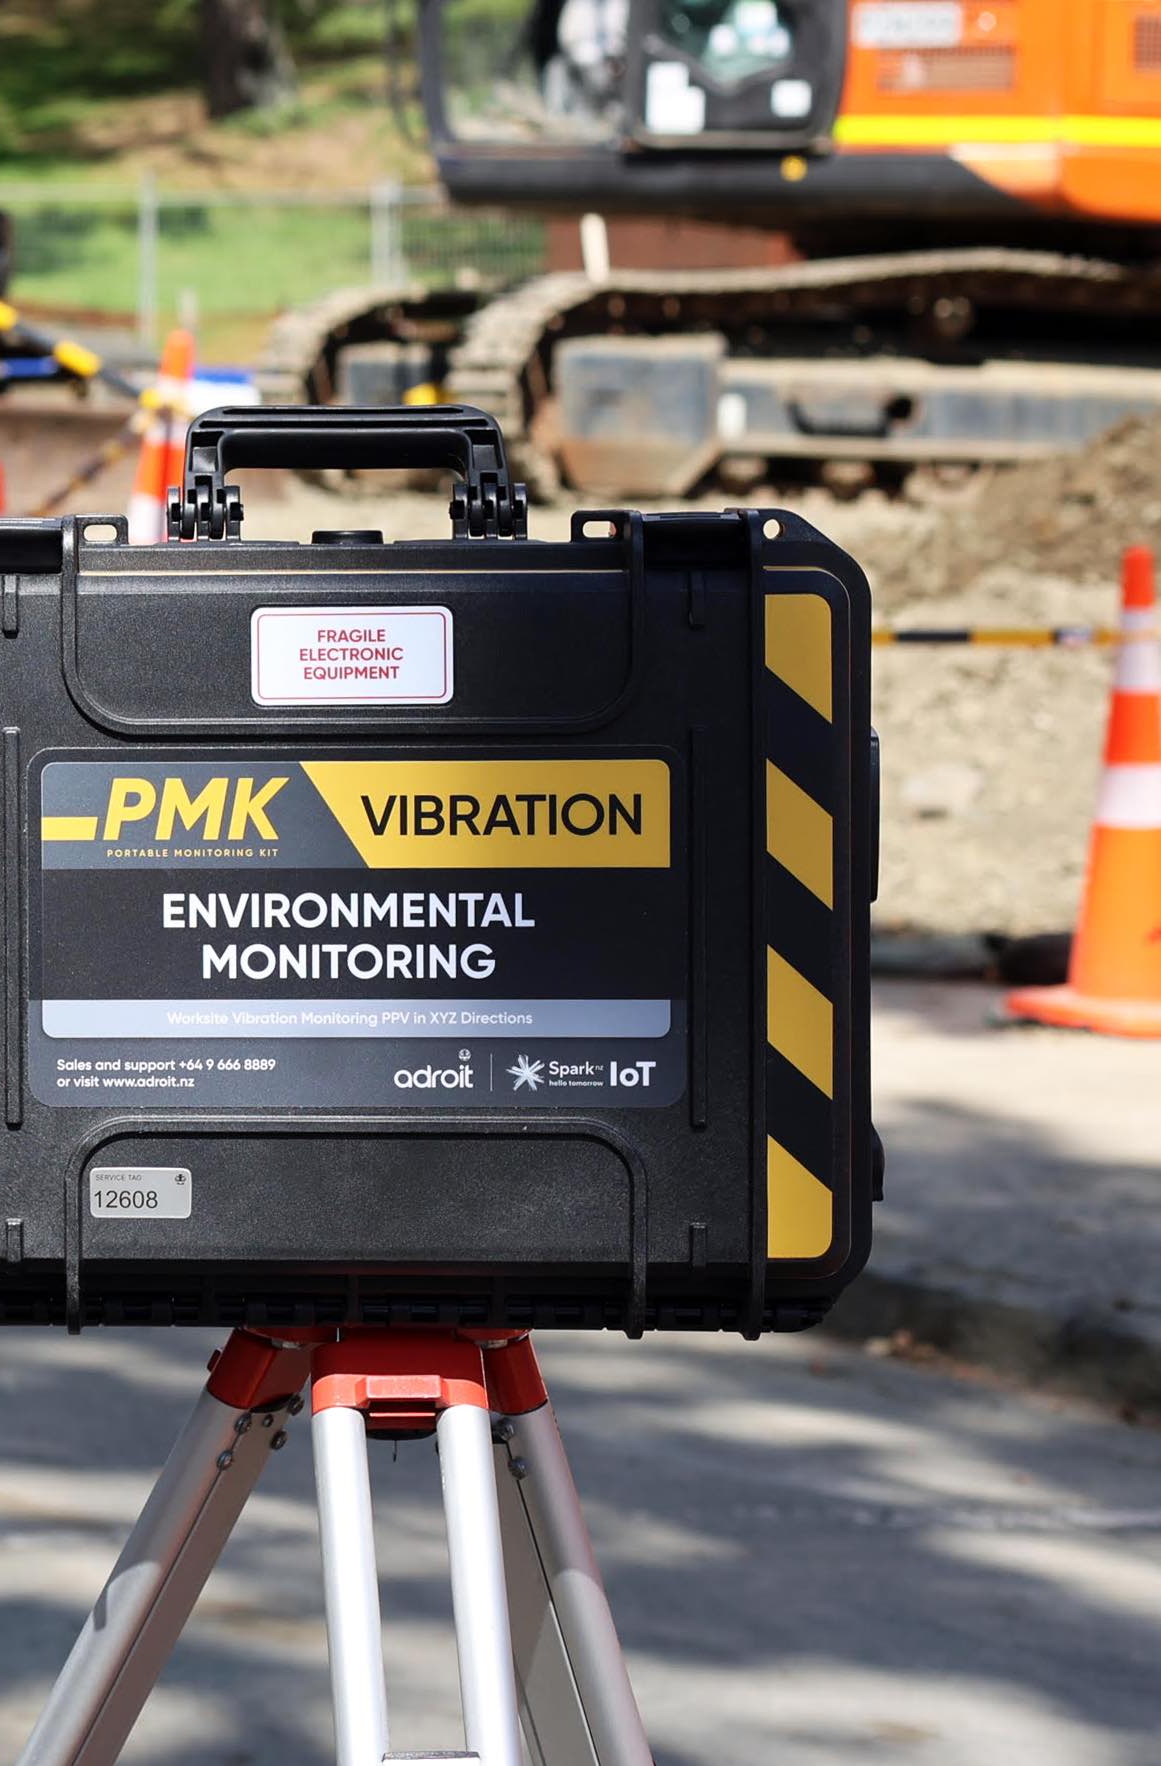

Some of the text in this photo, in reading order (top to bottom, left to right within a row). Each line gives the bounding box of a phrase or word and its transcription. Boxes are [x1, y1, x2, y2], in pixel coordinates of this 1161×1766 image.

[317, 629, 386, 643] FRAGILE
[299, 647, 404, 661] ELECTRONIC
[304, 666, 400, 680] EQUIPMENT
[103, 777, 290, 840] PMK
[360, 793, 642, 836] VIBRATION
[107, 849, 279, 857] PORTABLE MONITORING KIT
[163, 893, 535, 928] ENVIRONMENTAL
[202, 943, 496, 980] MONITORING
[167, 1010, 533, 1027] Worksite Vibration Monitoring PPV in XYZ Directions
[56, 1059, 276, 1073] Sales and support +64 9 666 8889
[549, 1061, 595, 1076] Spark
[610, 1061, 656, 1087] IoT
[56, 1075, 195, 1088] or visit www.adroit.nz
[394, 1062, 474, 1088] adroit
[94, 1190, 158, 1208] 12608
